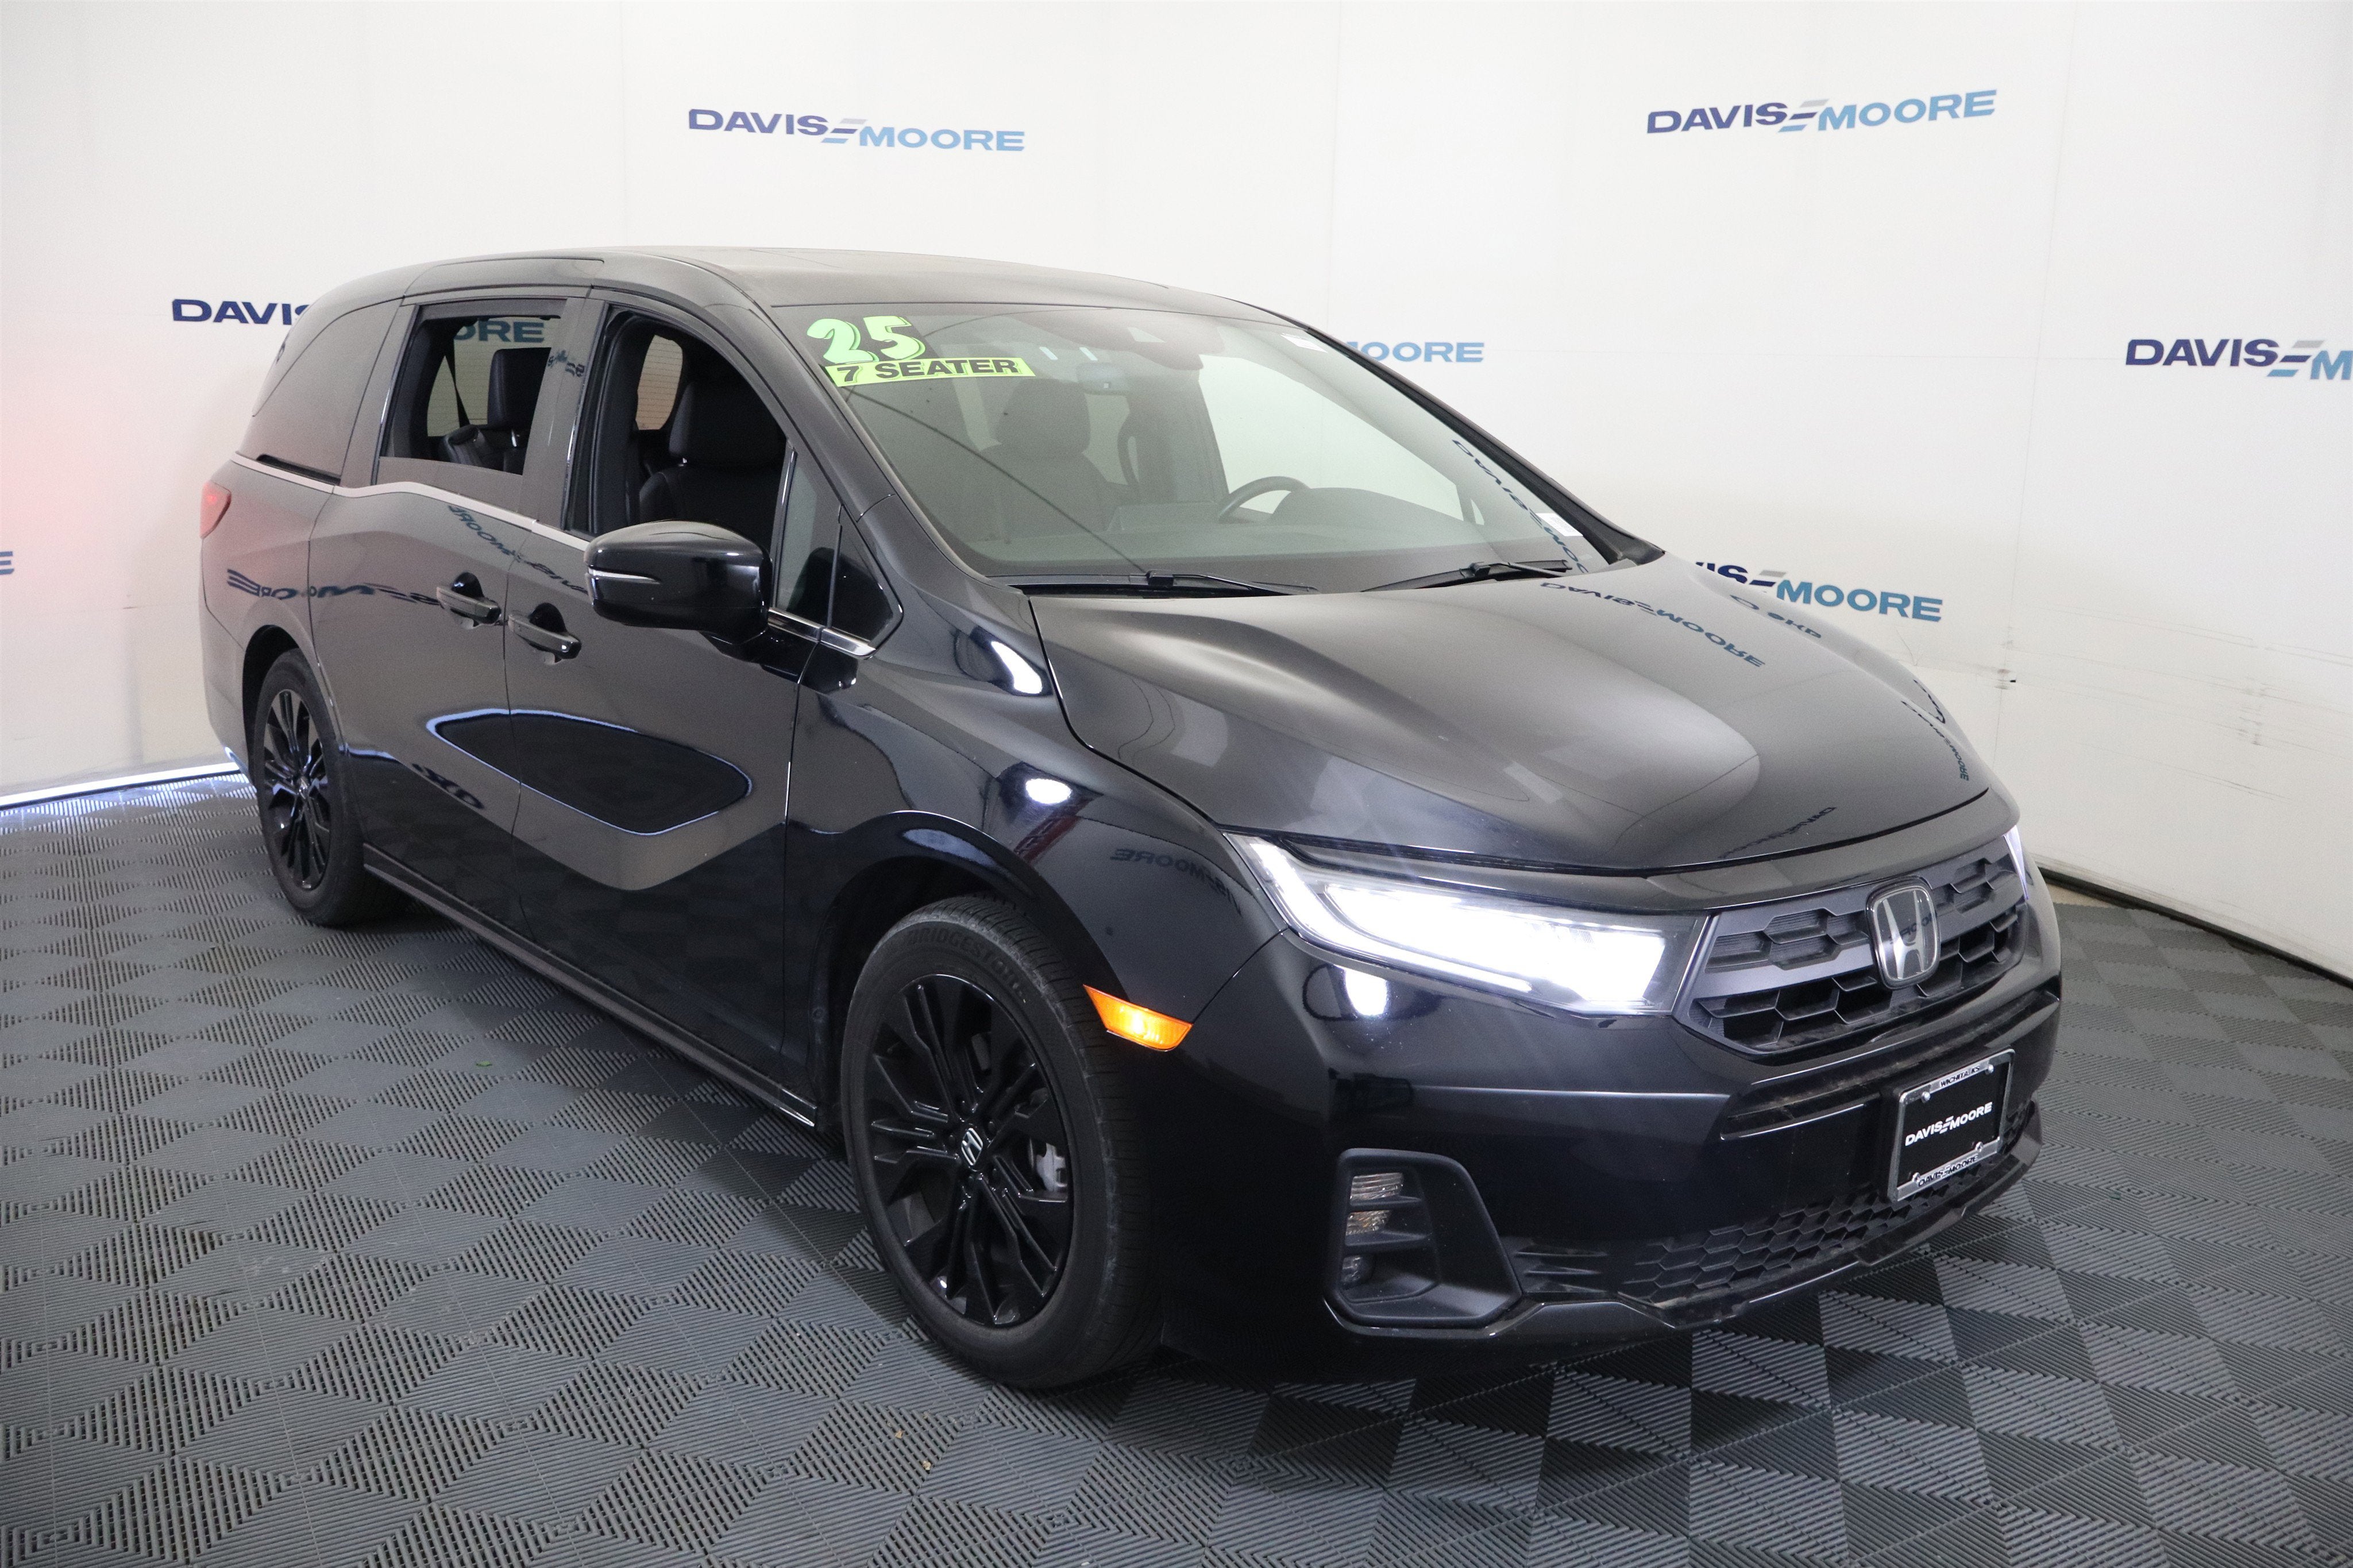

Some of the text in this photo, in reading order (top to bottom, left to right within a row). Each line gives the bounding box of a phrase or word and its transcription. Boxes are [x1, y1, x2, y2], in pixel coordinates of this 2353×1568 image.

[689, 109, 1025, 151] DAVIS MOORE
[1646, 89, 1997, 134] DAVIS MOORE
[807, 315, 925, 364] 25
[2126, 339, 2279, 366] DAVIS
[837, 359, 1021, 383] 7 SEATER
[1777, 580, 1943, 622] MOORE
[1904, 1101, 1993, 1146] DAVIS MOORE
